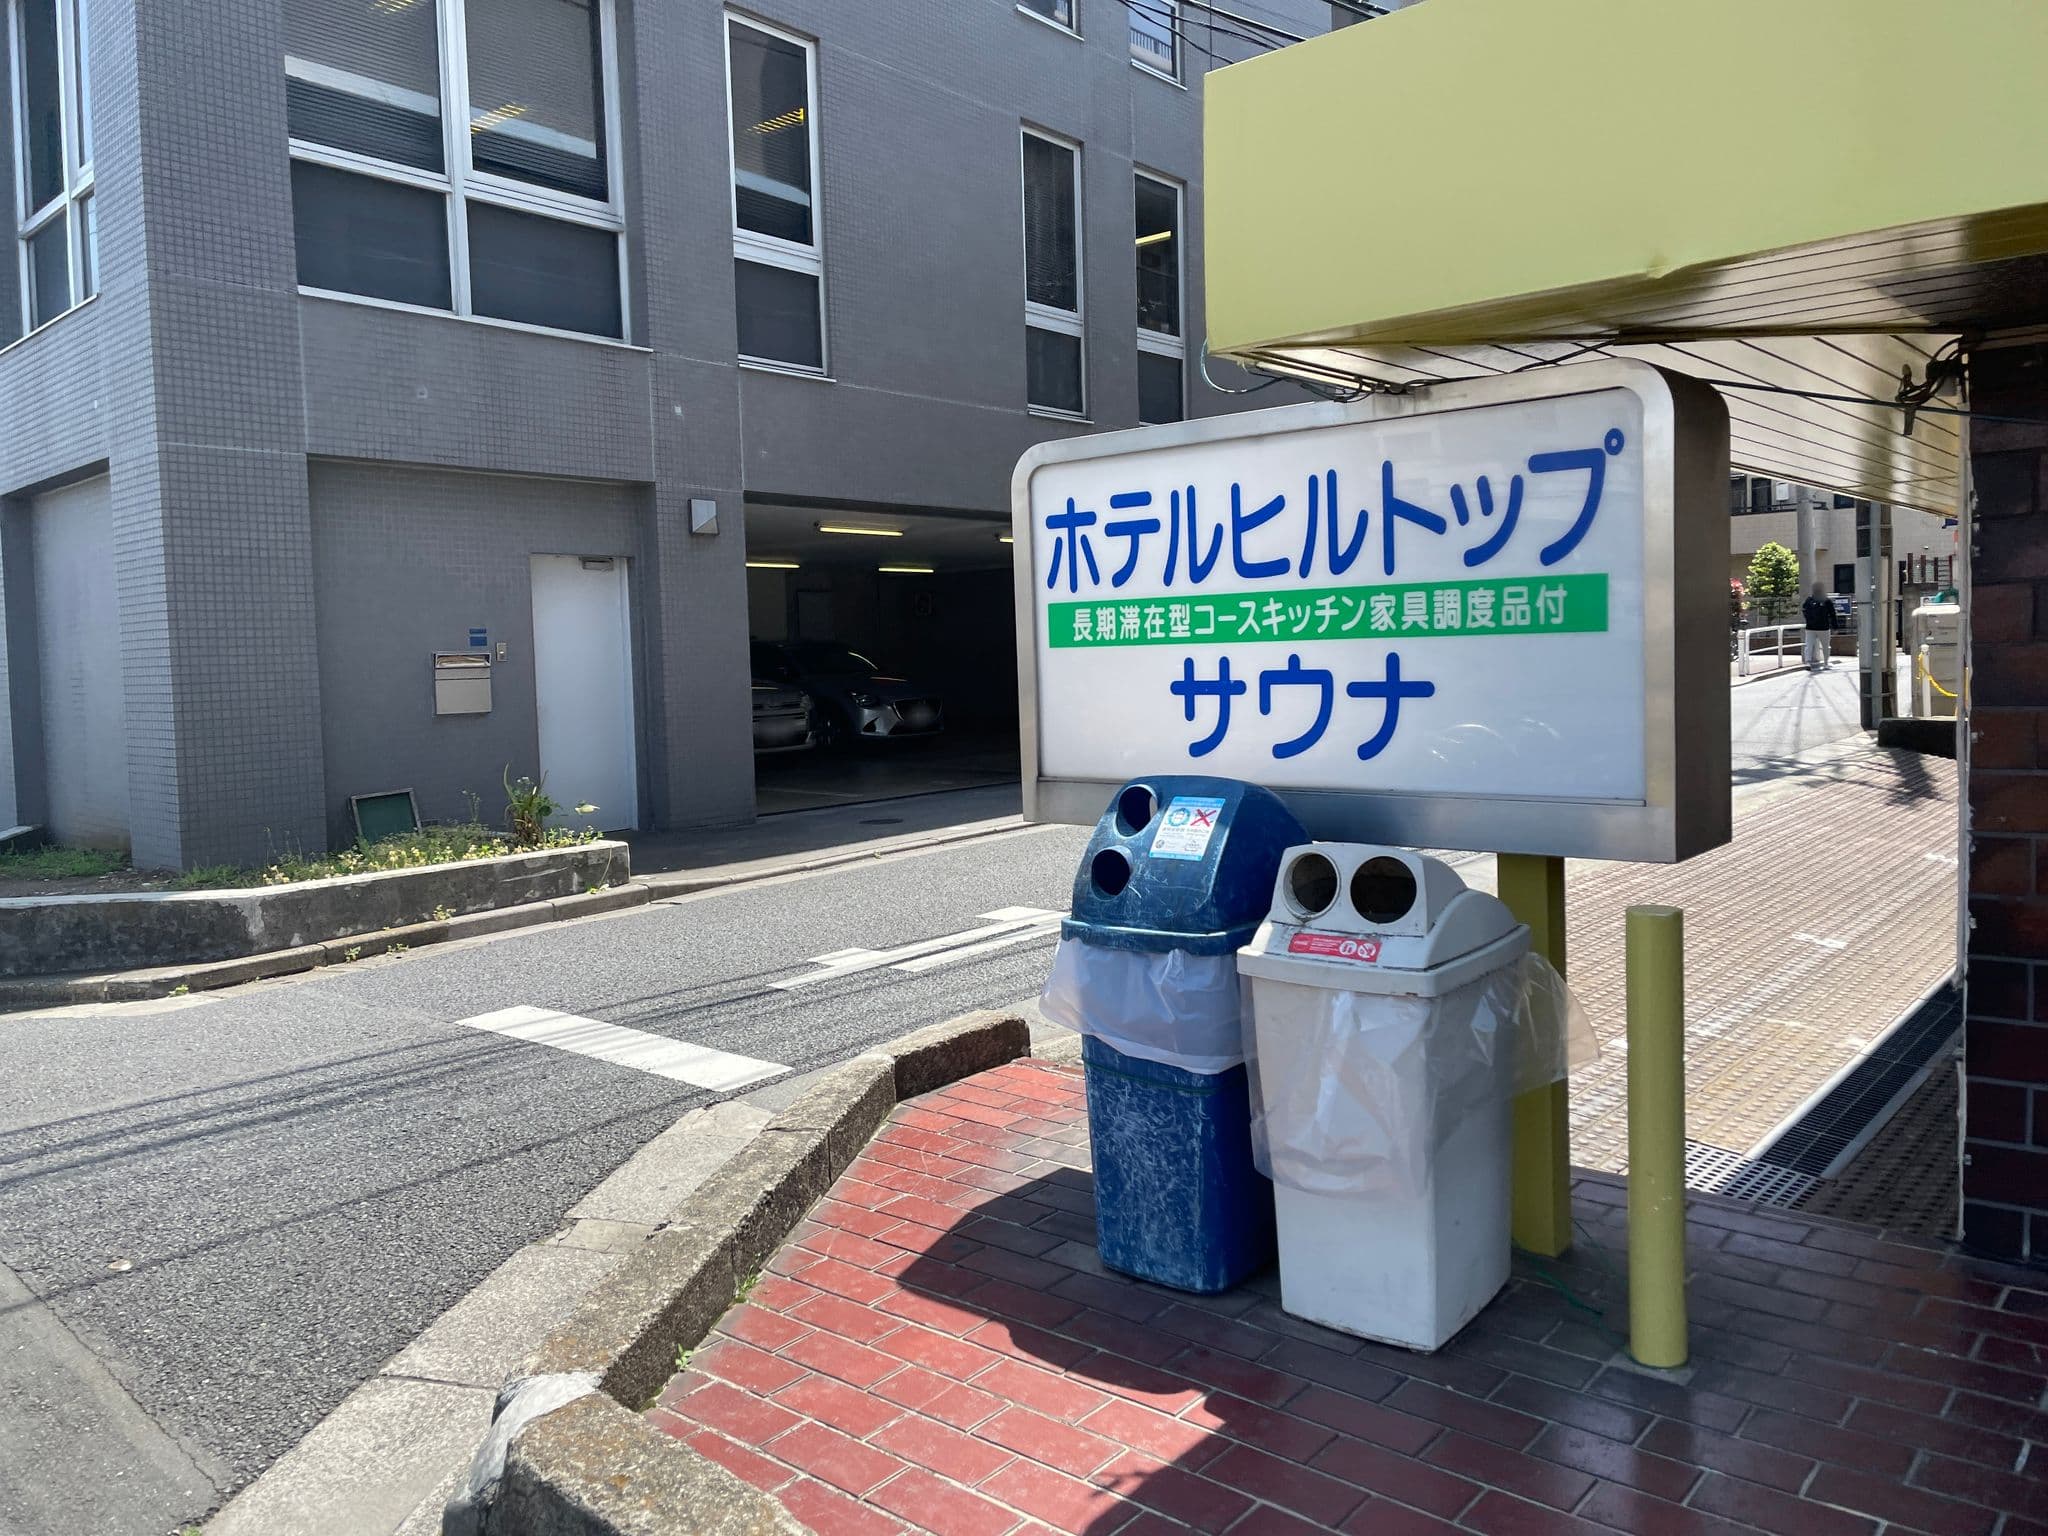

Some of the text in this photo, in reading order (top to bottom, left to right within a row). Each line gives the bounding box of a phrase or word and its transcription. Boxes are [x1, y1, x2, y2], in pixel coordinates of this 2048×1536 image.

[1045, 427, 1625, 593] ホテルヒルトップ
[1072, 583, 1567, 642] 長期滞在型コースキッチン家具調度品付
[1170, 652, 1435, 760] サウナ
